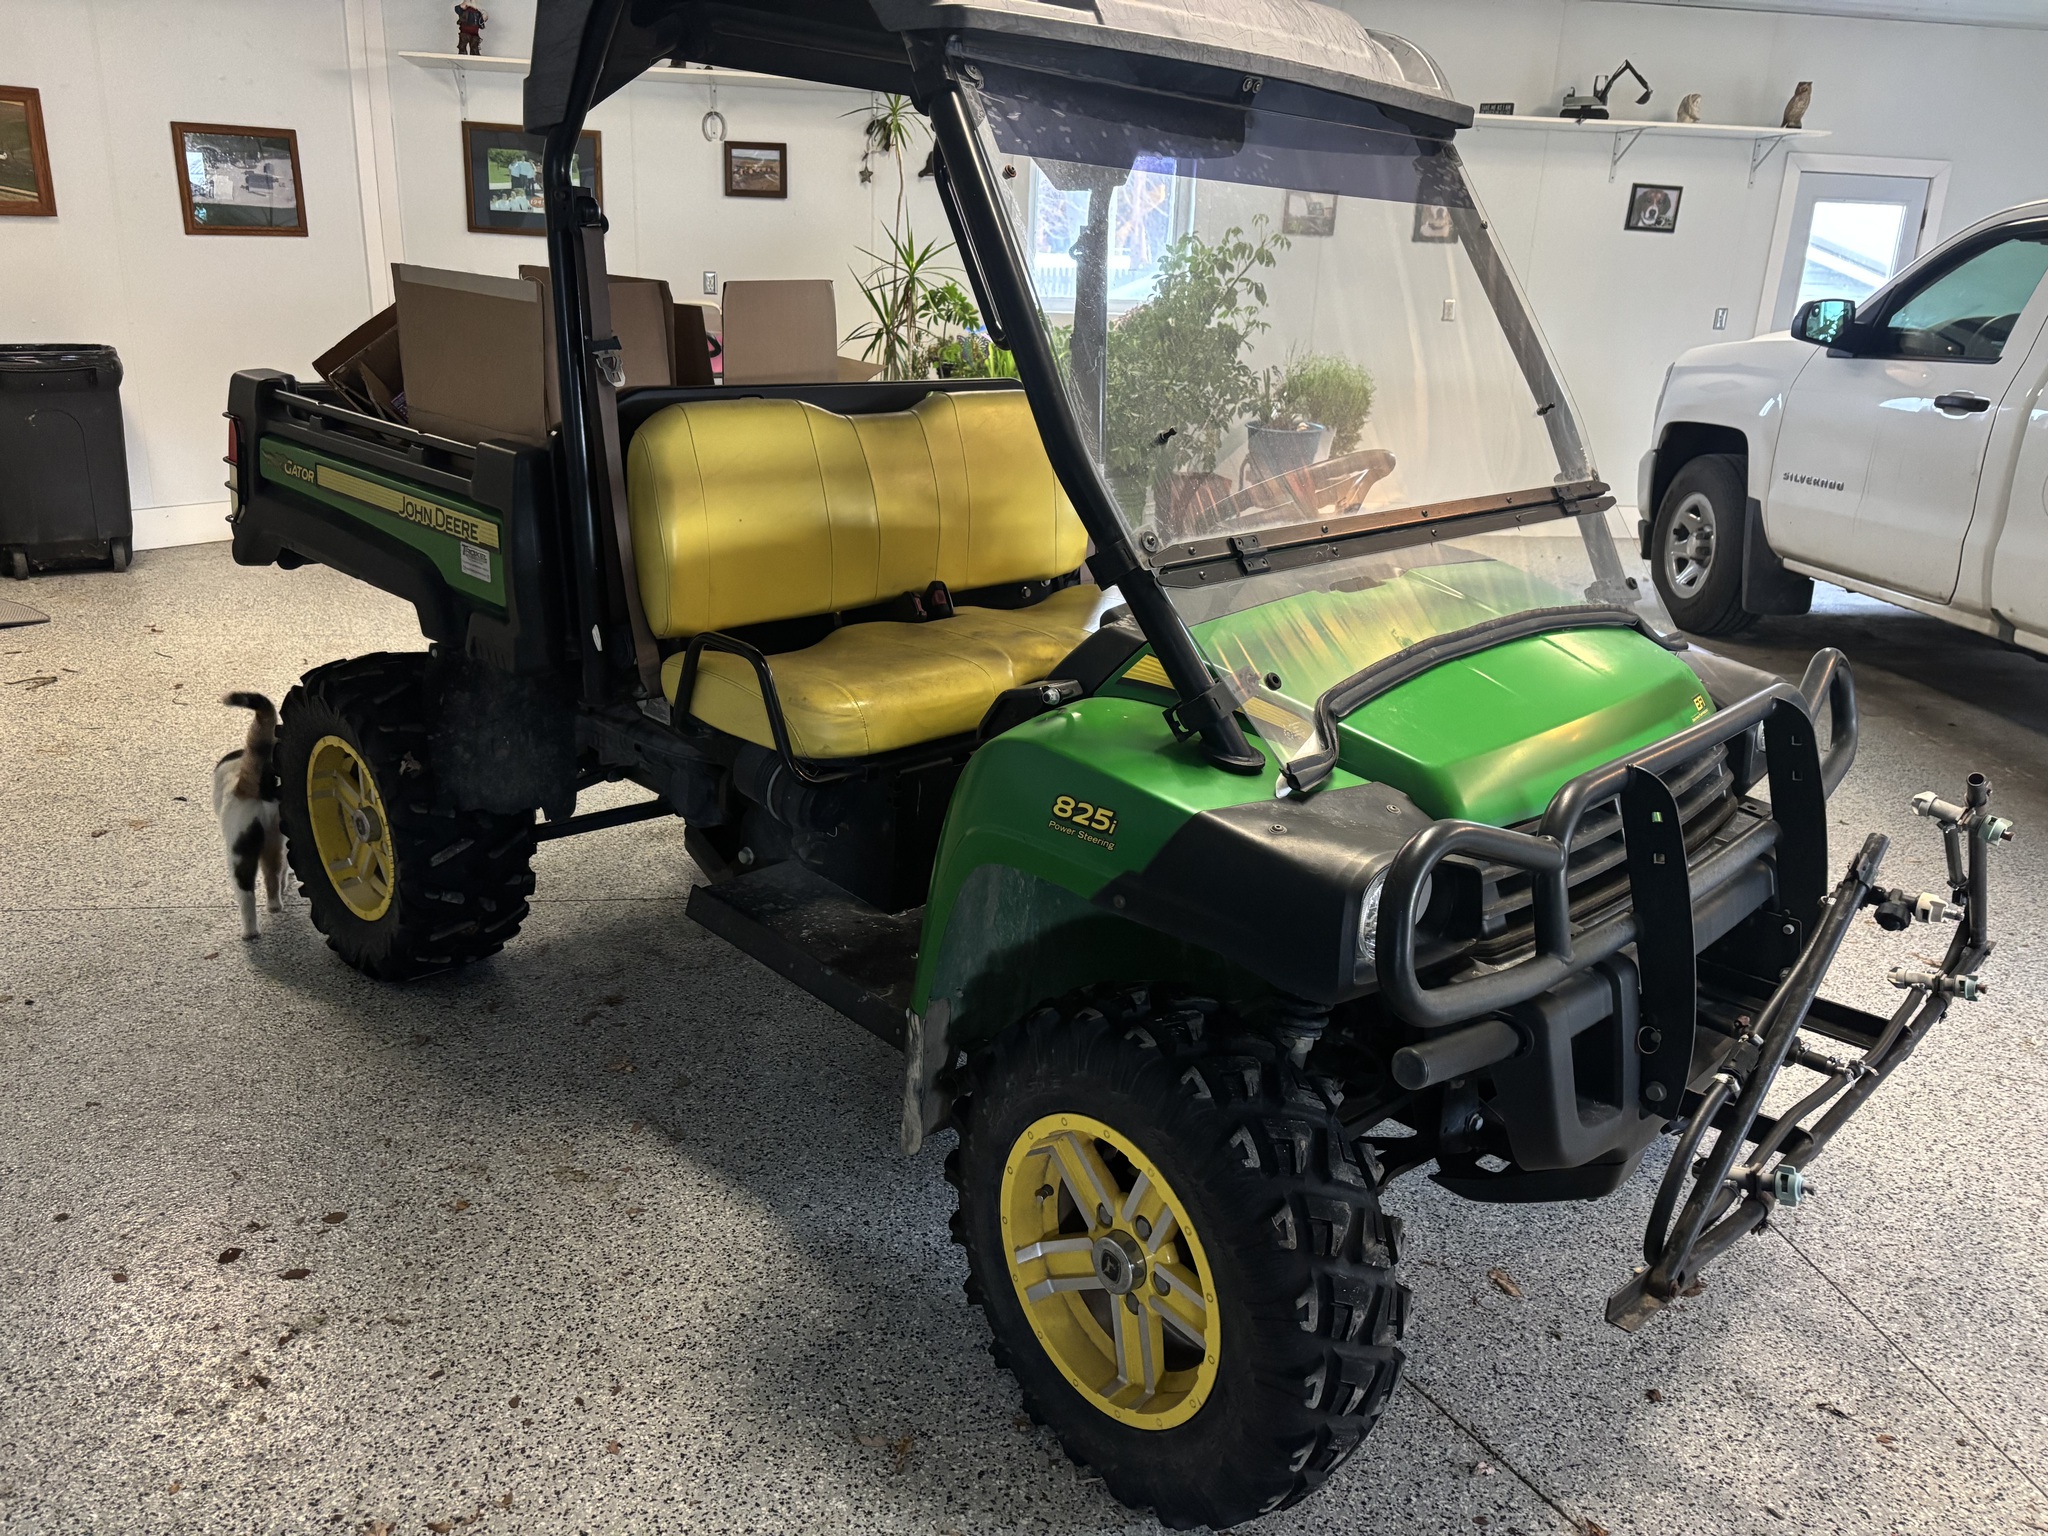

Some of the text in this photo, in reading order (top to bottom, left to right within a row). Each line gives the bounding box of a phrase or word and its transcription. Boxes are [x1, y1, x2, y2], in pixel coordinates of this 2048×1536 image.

[284, 460, 315, 483] GATOR
[1782, 472, 1844, 491] SILVERADO
[399, 496, 479, 541] JOHN DEERE
[1052, 795, 1117, 834] 825i
[1048, 820, 1116, 850] Power Steering
